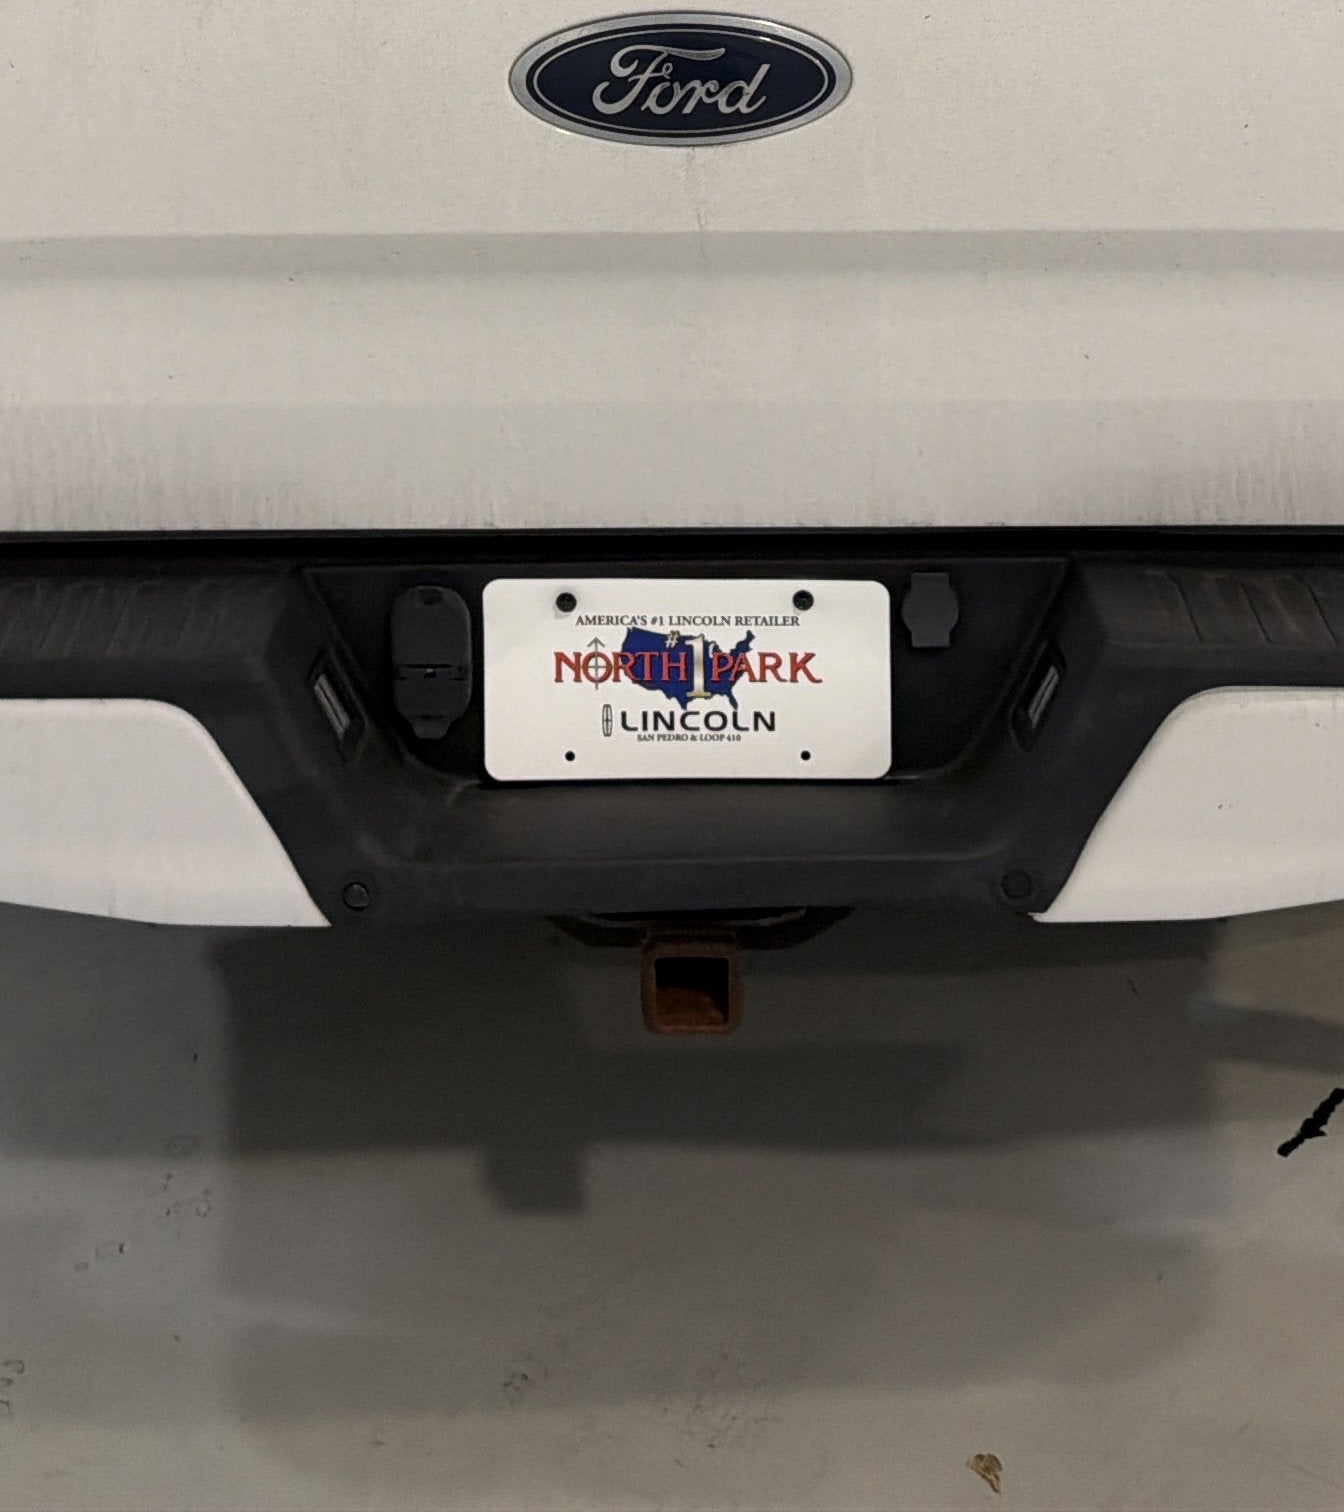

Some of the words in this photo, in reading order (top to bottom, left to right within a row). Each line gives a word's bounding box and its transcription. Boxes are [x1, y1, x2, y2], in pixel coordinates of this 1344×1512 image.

[592, 44, 771, 115] Ford
[575, 614, 648, 627] AMERICA'S
[650, 615, 665, 627] #1
[668, 615, 731, 627] LINCOLN
[734, 615, 801, 627] RETAILER
[553, 651, 688, 684] NORTH
[711, 651, 824, 684] PARK
[620, 710, 776, 732] LINCOLN
[637, 733, 656, 742] SAN
[657, 733, 689, 742] PEDRO
